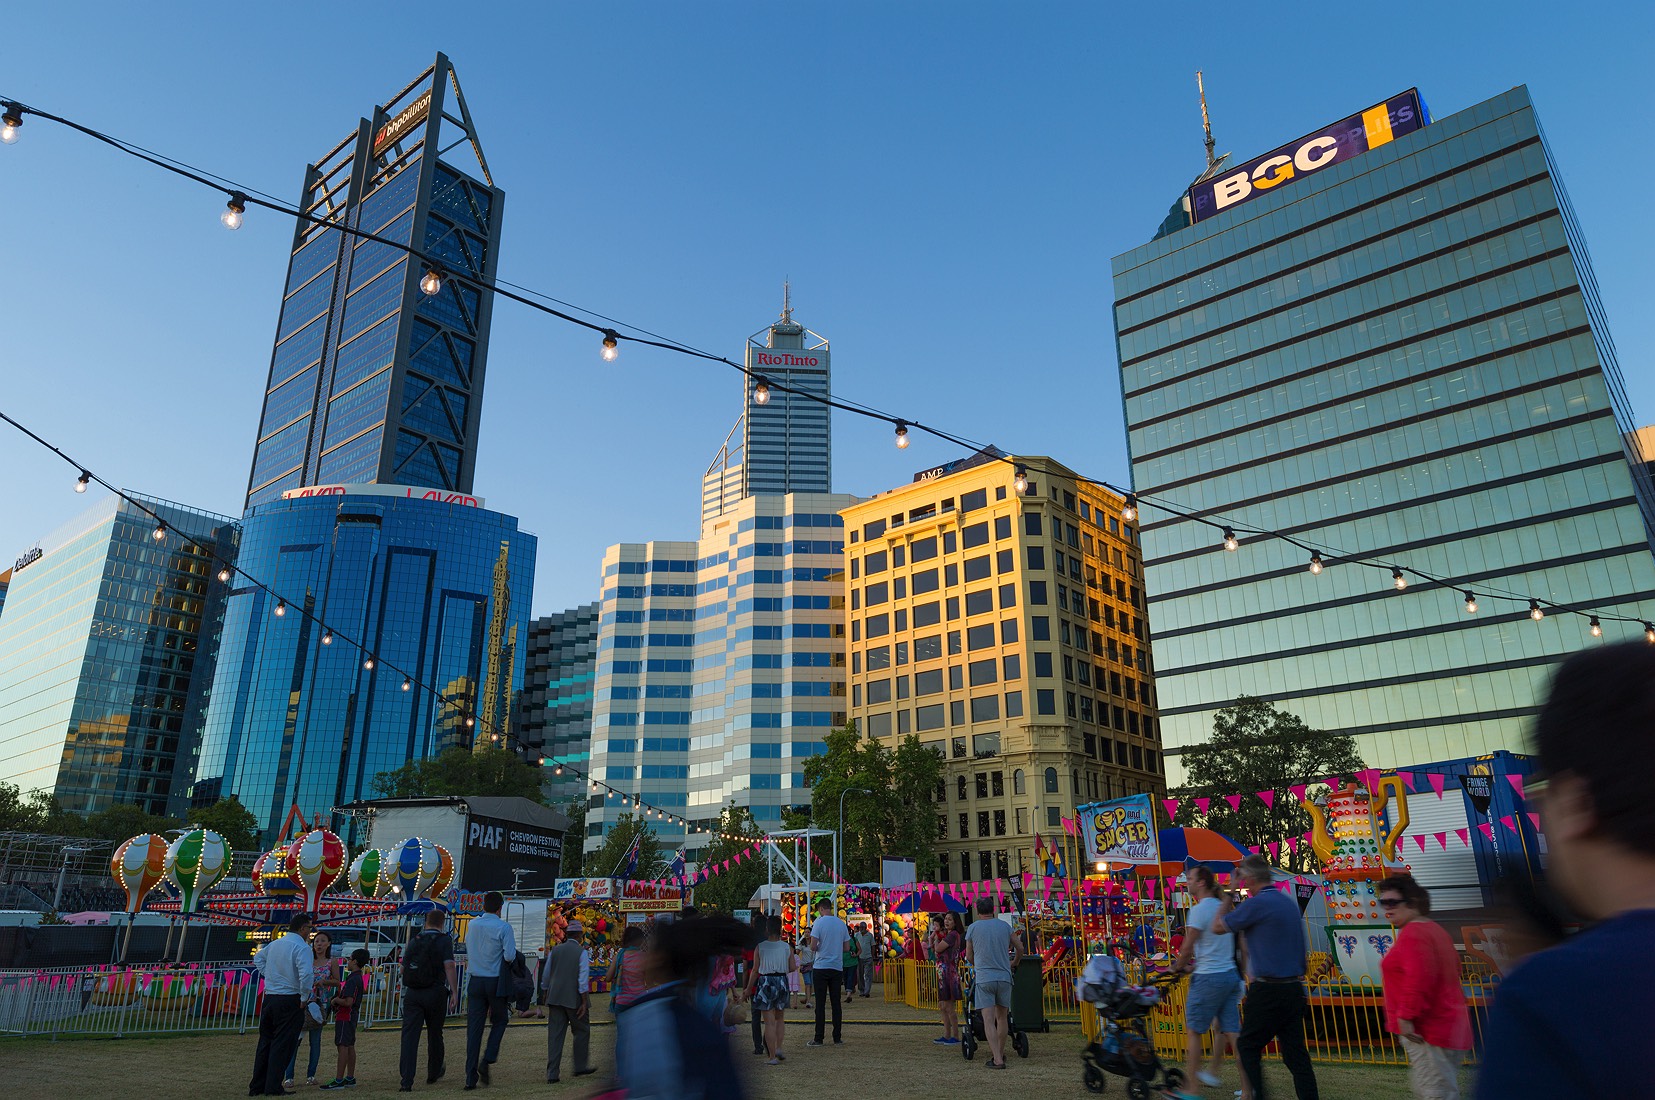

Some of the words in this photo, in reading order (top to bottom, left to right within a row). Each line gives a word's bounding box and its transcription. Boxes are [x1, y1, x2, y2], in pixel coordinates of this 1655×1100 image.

[387, 95, 430, 137] bhpbilliton
[1213, 135, 1338, 210] BGC
[920, 467, 944, 481] AMP
[1466, 777, 1488, 788] FRINGE
[1467, 786, 1491, 797] WORLD
[1126, 809, 1141, 820] and
[468, 822, 504, 850] PIAF
[509, 831, 539, 844] CHEVRON
[538, 836, 561, 848] FESTIVAL
[509, 842, 538, 856] GARDENS
[1127, 841, 1150, 858] ride
[556, 880, 573, 889] EASY
[591, 879, 607, 889] BIG
[556, 888, 573, 898] PLAY
[633, 901, 667, 910] TICKETS
